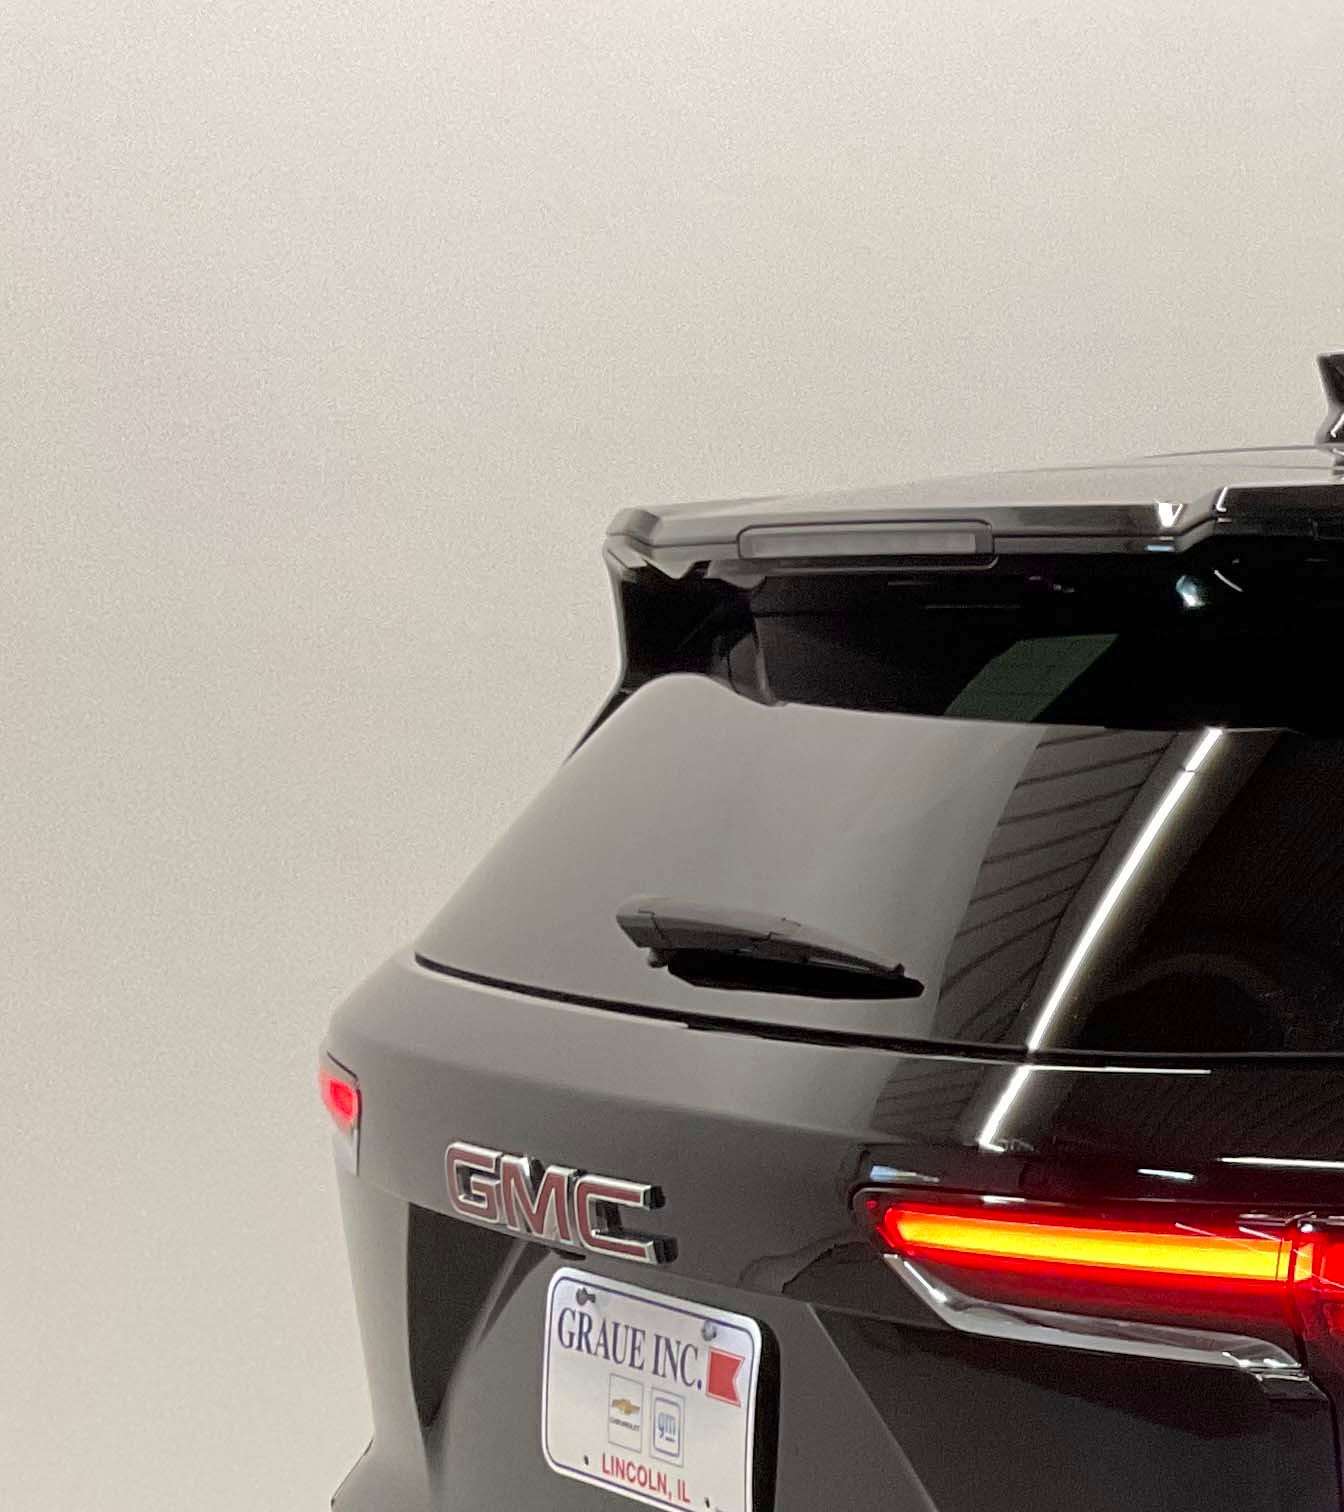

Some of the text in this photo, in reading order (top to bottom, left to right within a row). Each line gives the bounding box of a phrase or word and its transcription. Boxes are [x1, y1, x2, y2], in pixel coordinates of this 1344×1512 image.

[445, 1141, 667, 1265] GMC
[557, 1306, 702, 1390] GRAUE INC.
[602, 1452, 691, 1503] LINCOLN, IL
